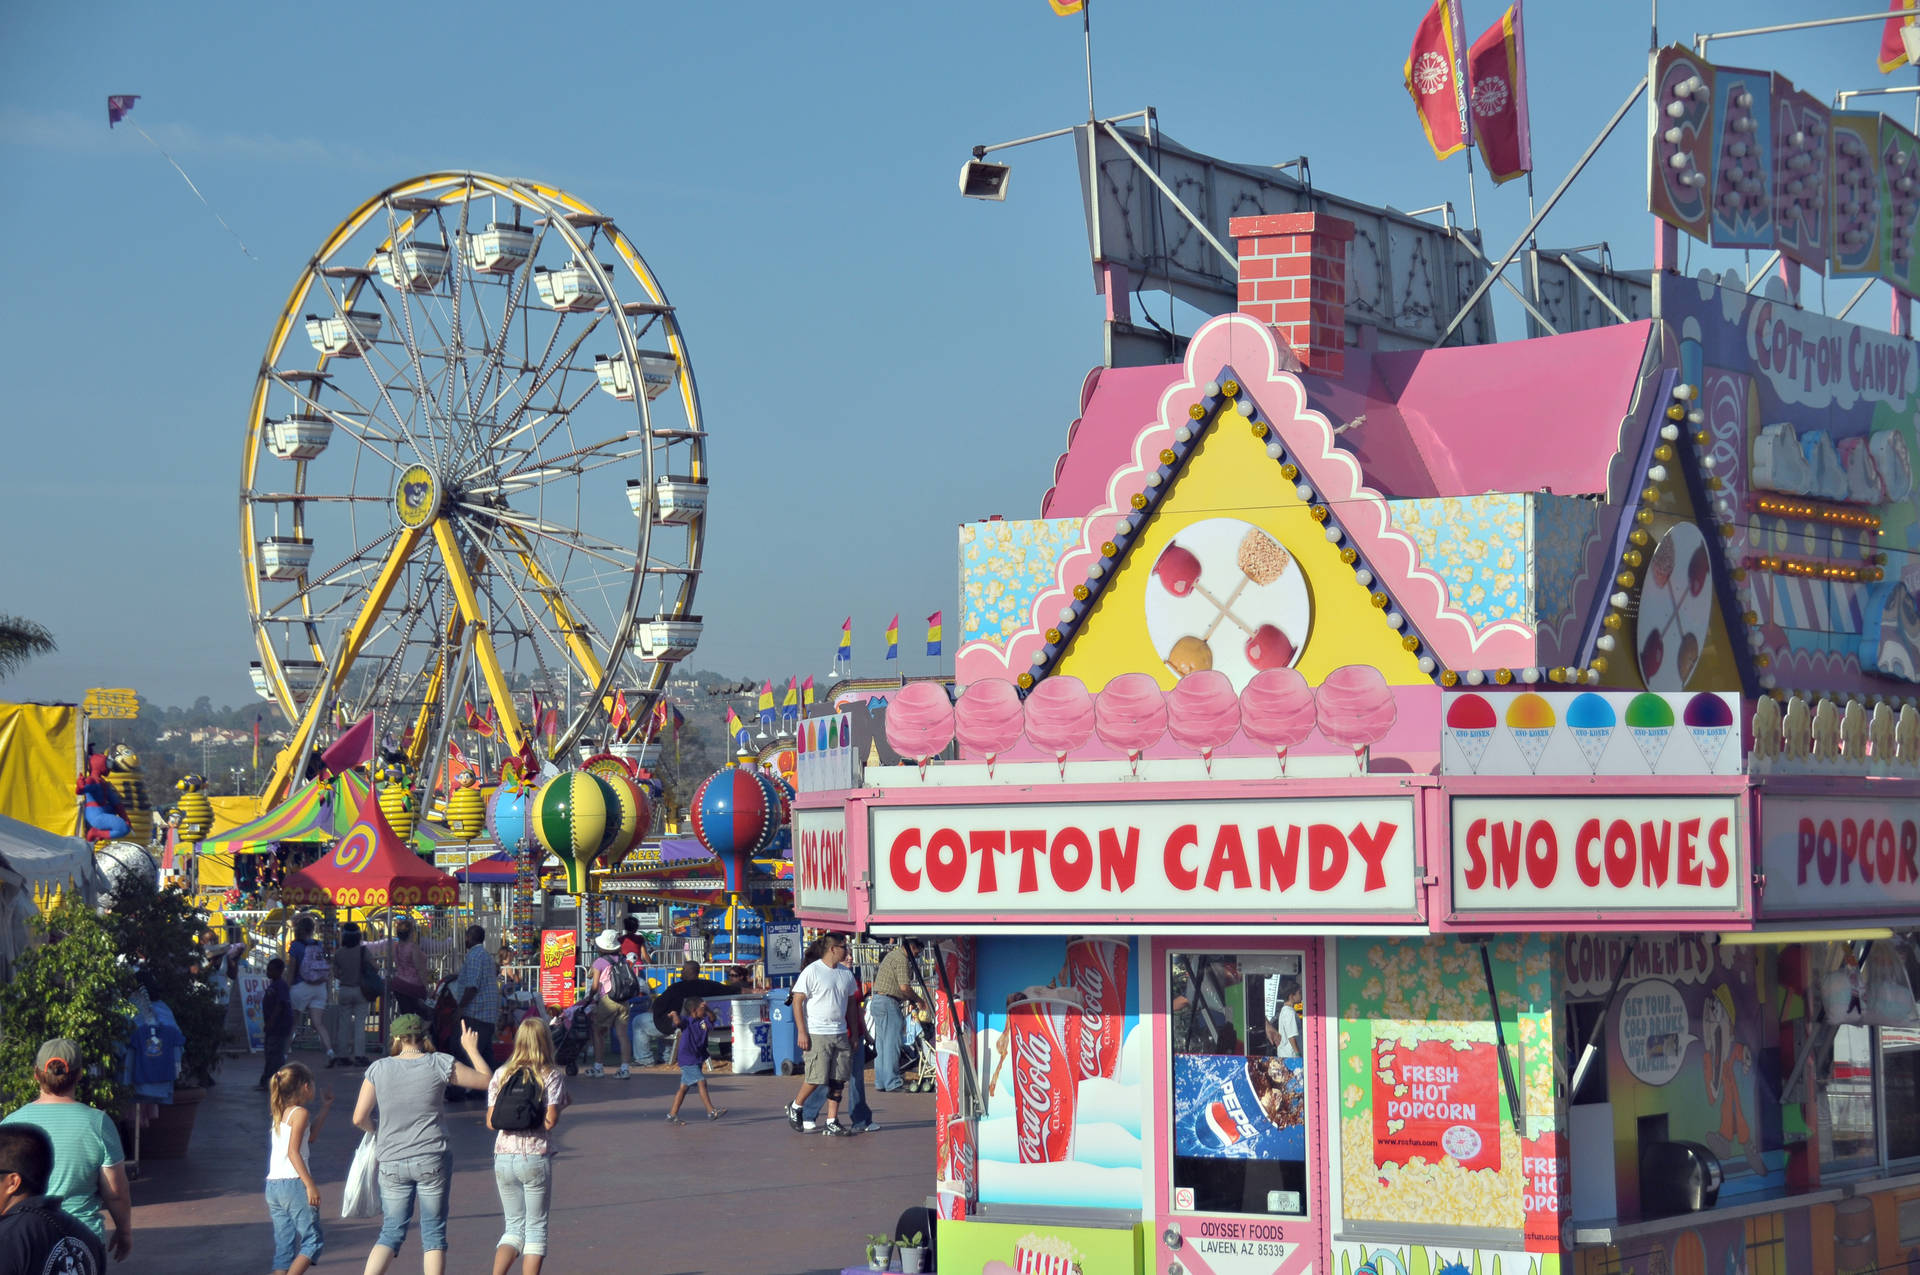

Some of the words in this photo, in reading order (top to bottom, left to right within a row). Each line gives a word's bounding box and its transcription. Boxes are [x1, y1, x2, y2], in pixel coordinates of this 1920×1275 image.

[1755, 301, 1842, 393] COTTON
[1848, 325, 1911, 400] CANDY
[801, 829, 818, 891] SNO
[820, 828, 847, 893] CONE
[889, 825, 1140, 894] COTTON
[1163, 820, 1399, 894] CANDY
[1463, 817, 1558, 891] SNO
[1574, 816, 1730, 890] CONES
[1565, 930, 1708, 985] CONDIMENTS
[1624, 997, 1643, 1017] GET
[1104, 1013, 1112, 1046] CLASSIC
[1624, 1017, 1647, 1039] COLD
[1402, 1065, 1459, 1083] FRESH
[1412, 1084, 1451, 1101] HOT
[1052, 1087, 1061, 1131] CLASSIC
[1387, 1101, 1477, 1120] POPCORN
[1200, 1222, 1246, 1239] ODYSSEY
[1249, 1224, 1284, 1241] FOODS
[1200, 1240, 1239, 1256] LAVEEN,
[1241, 1242, 1254, 1255] AZ
[1257, 1243, 1285, 1257] 85339
